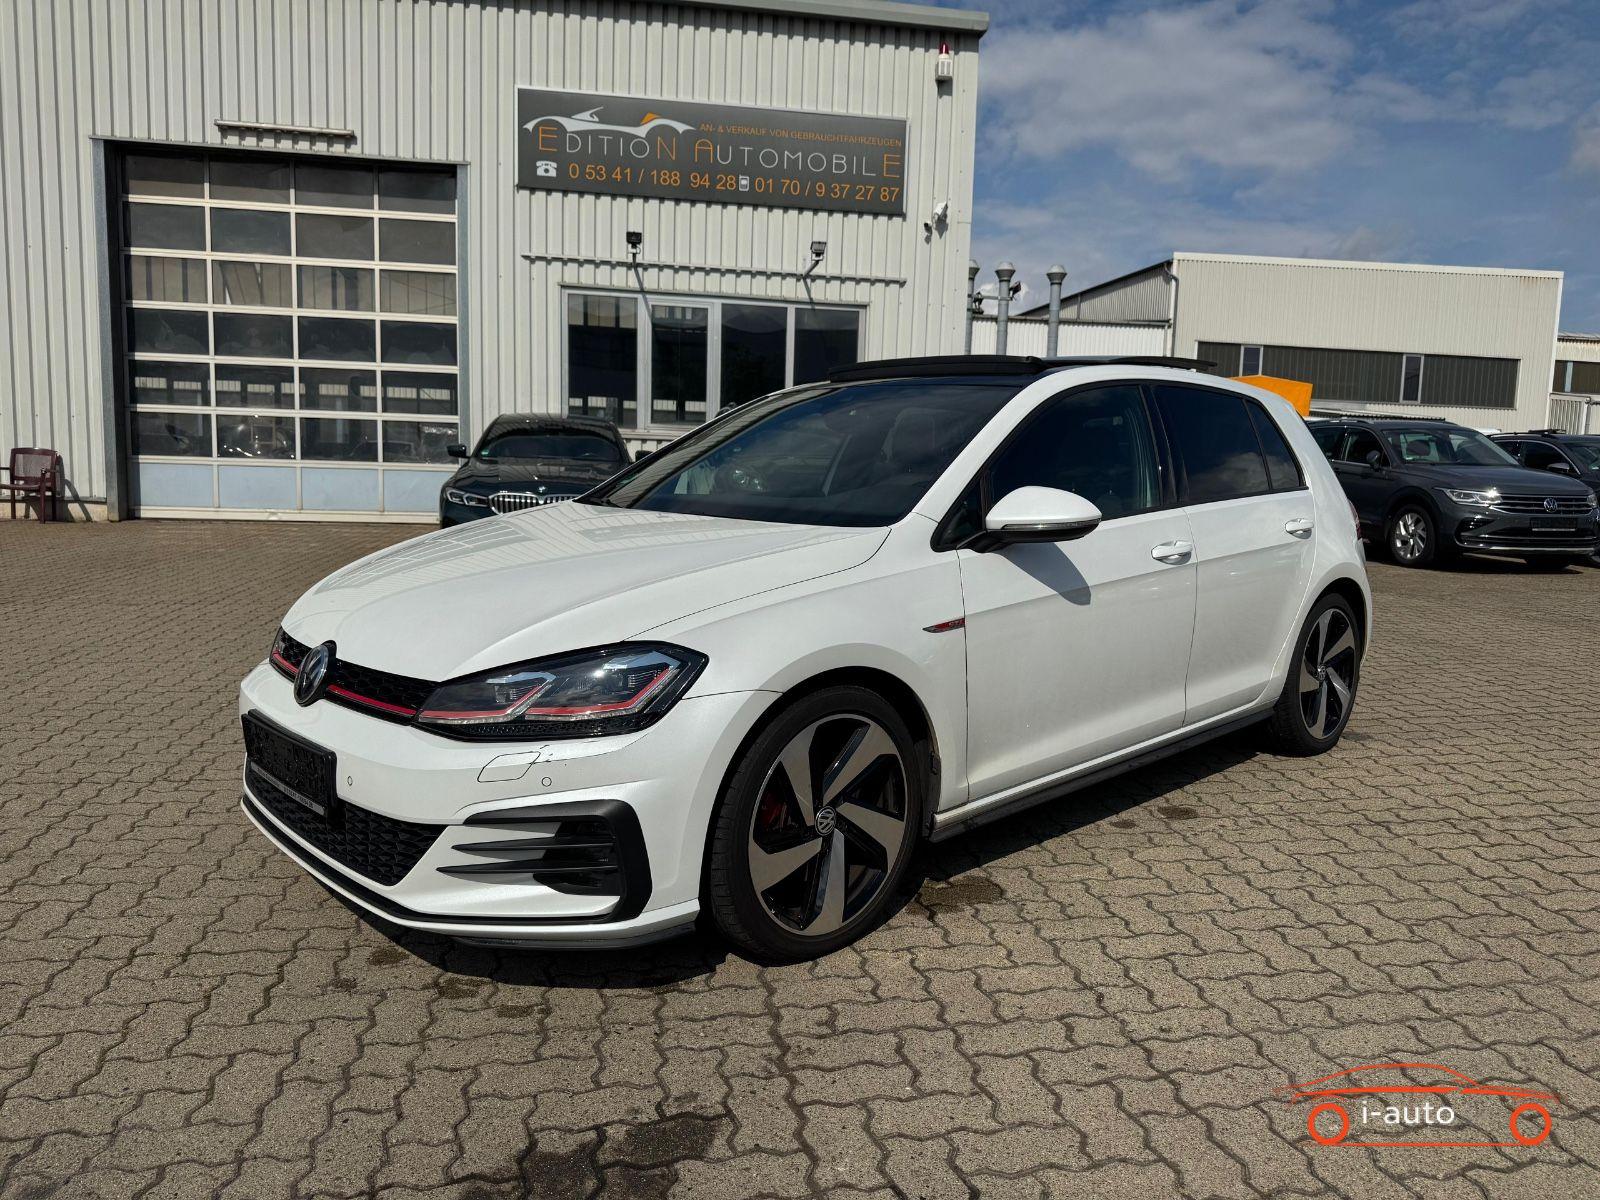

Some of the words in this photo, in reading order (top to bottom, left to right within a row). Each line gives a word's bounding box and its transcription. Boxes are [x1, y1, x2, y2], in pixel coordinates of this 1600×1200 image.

[726, 126, 769, 137] VERKAUF
[770, 129, 789, 138] VON
[790, 130, 902, 147] GEBRAUCHTFAHRZEUGEN
[538, 126, 676, 160] EDITION
[695, 139, 901, 177] AUTOMOBILE
[568, 163, 580, 179] 0
[585, 164, 607, 181] 53
[611, 166, 632, 184] 41
[650, 169, 681, 187] 188
[690, 172, 711, 190] 94
[716, 174, 737, 191] 28
[754, 177, 774, 193] 01
[781, 178, 801, 196] 70
[815, 182, 826, 197] 9
[830, 183, 850, 199] 37
[855, 185, 875, 201] 27
[880, 186, 900, 202] 87
